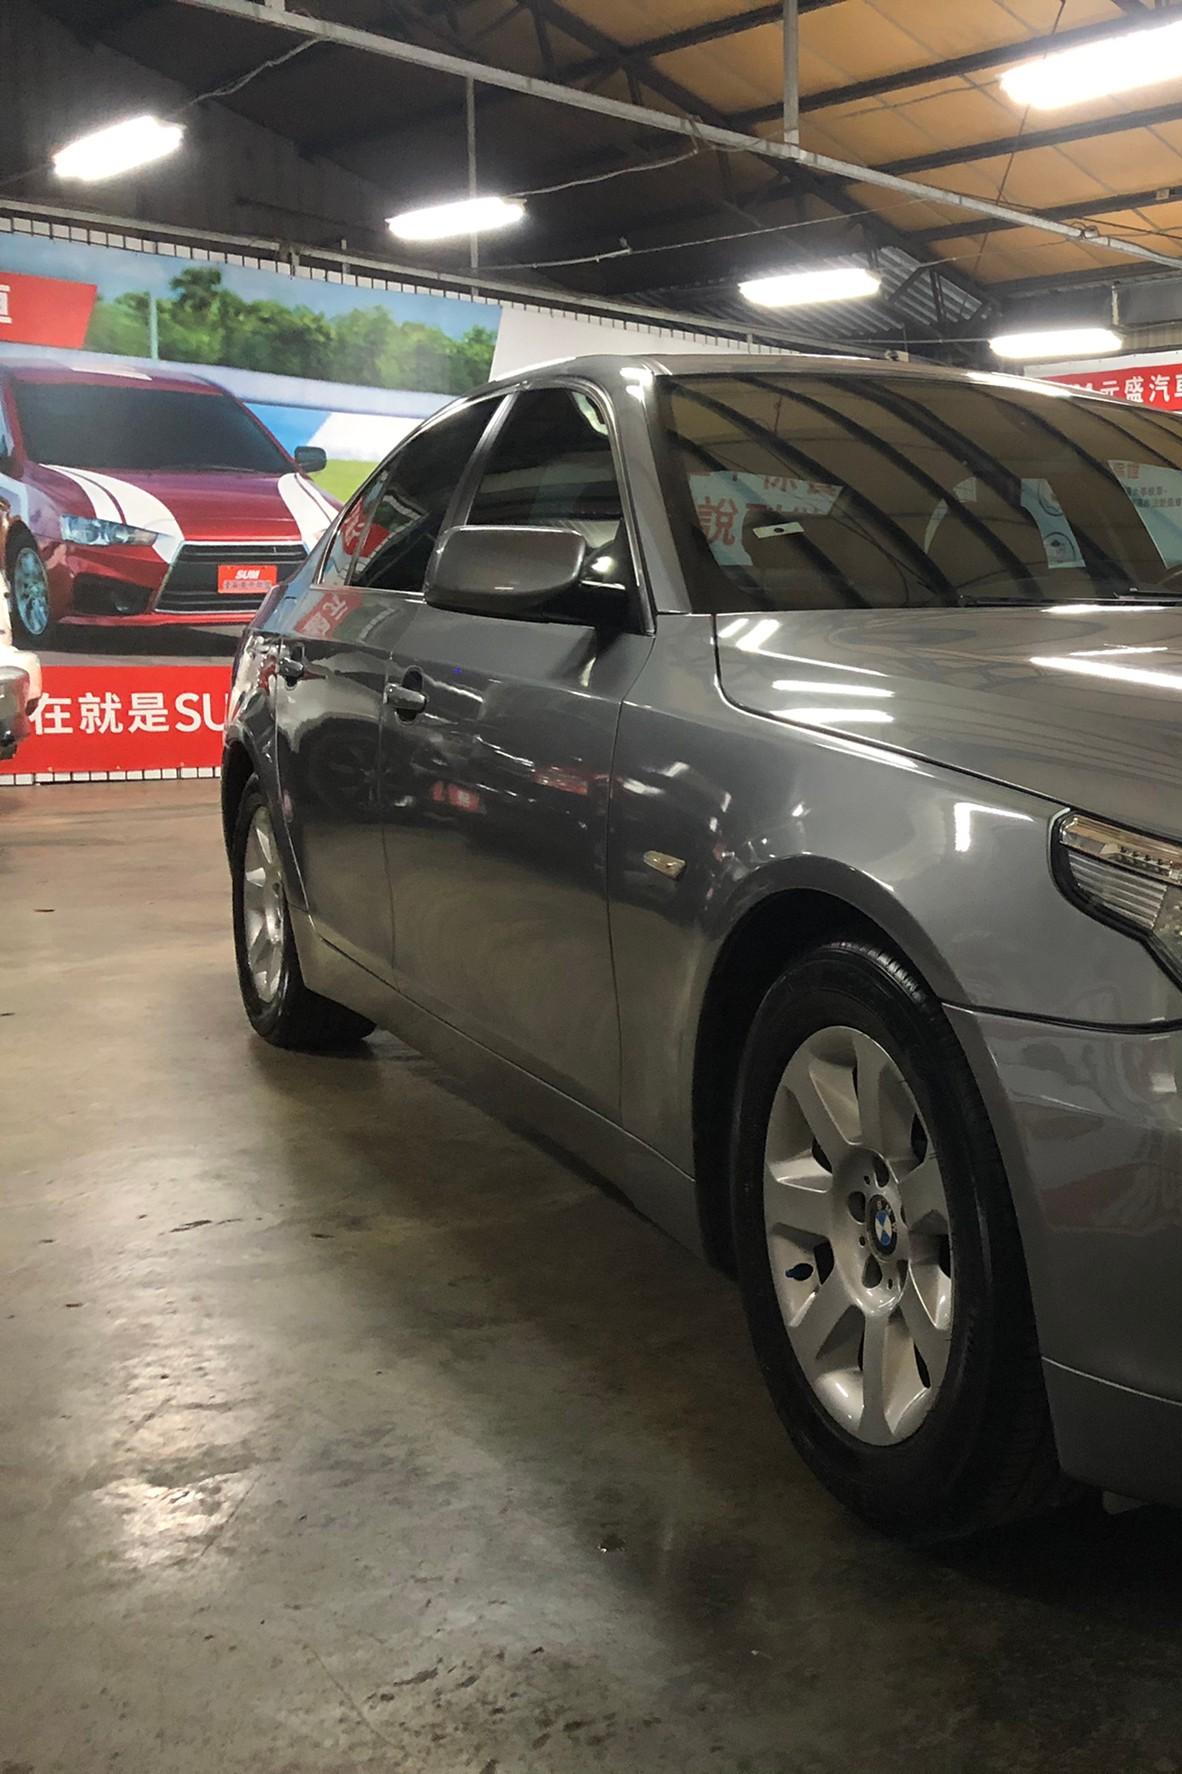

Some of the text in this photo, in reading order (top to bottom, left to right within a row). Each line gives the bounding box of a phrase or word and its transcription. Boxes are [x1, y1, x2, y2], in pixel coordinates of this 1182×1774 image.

[234, 569, 261, 580] SUM
[28, 692, 228, 735] 在就是SU
